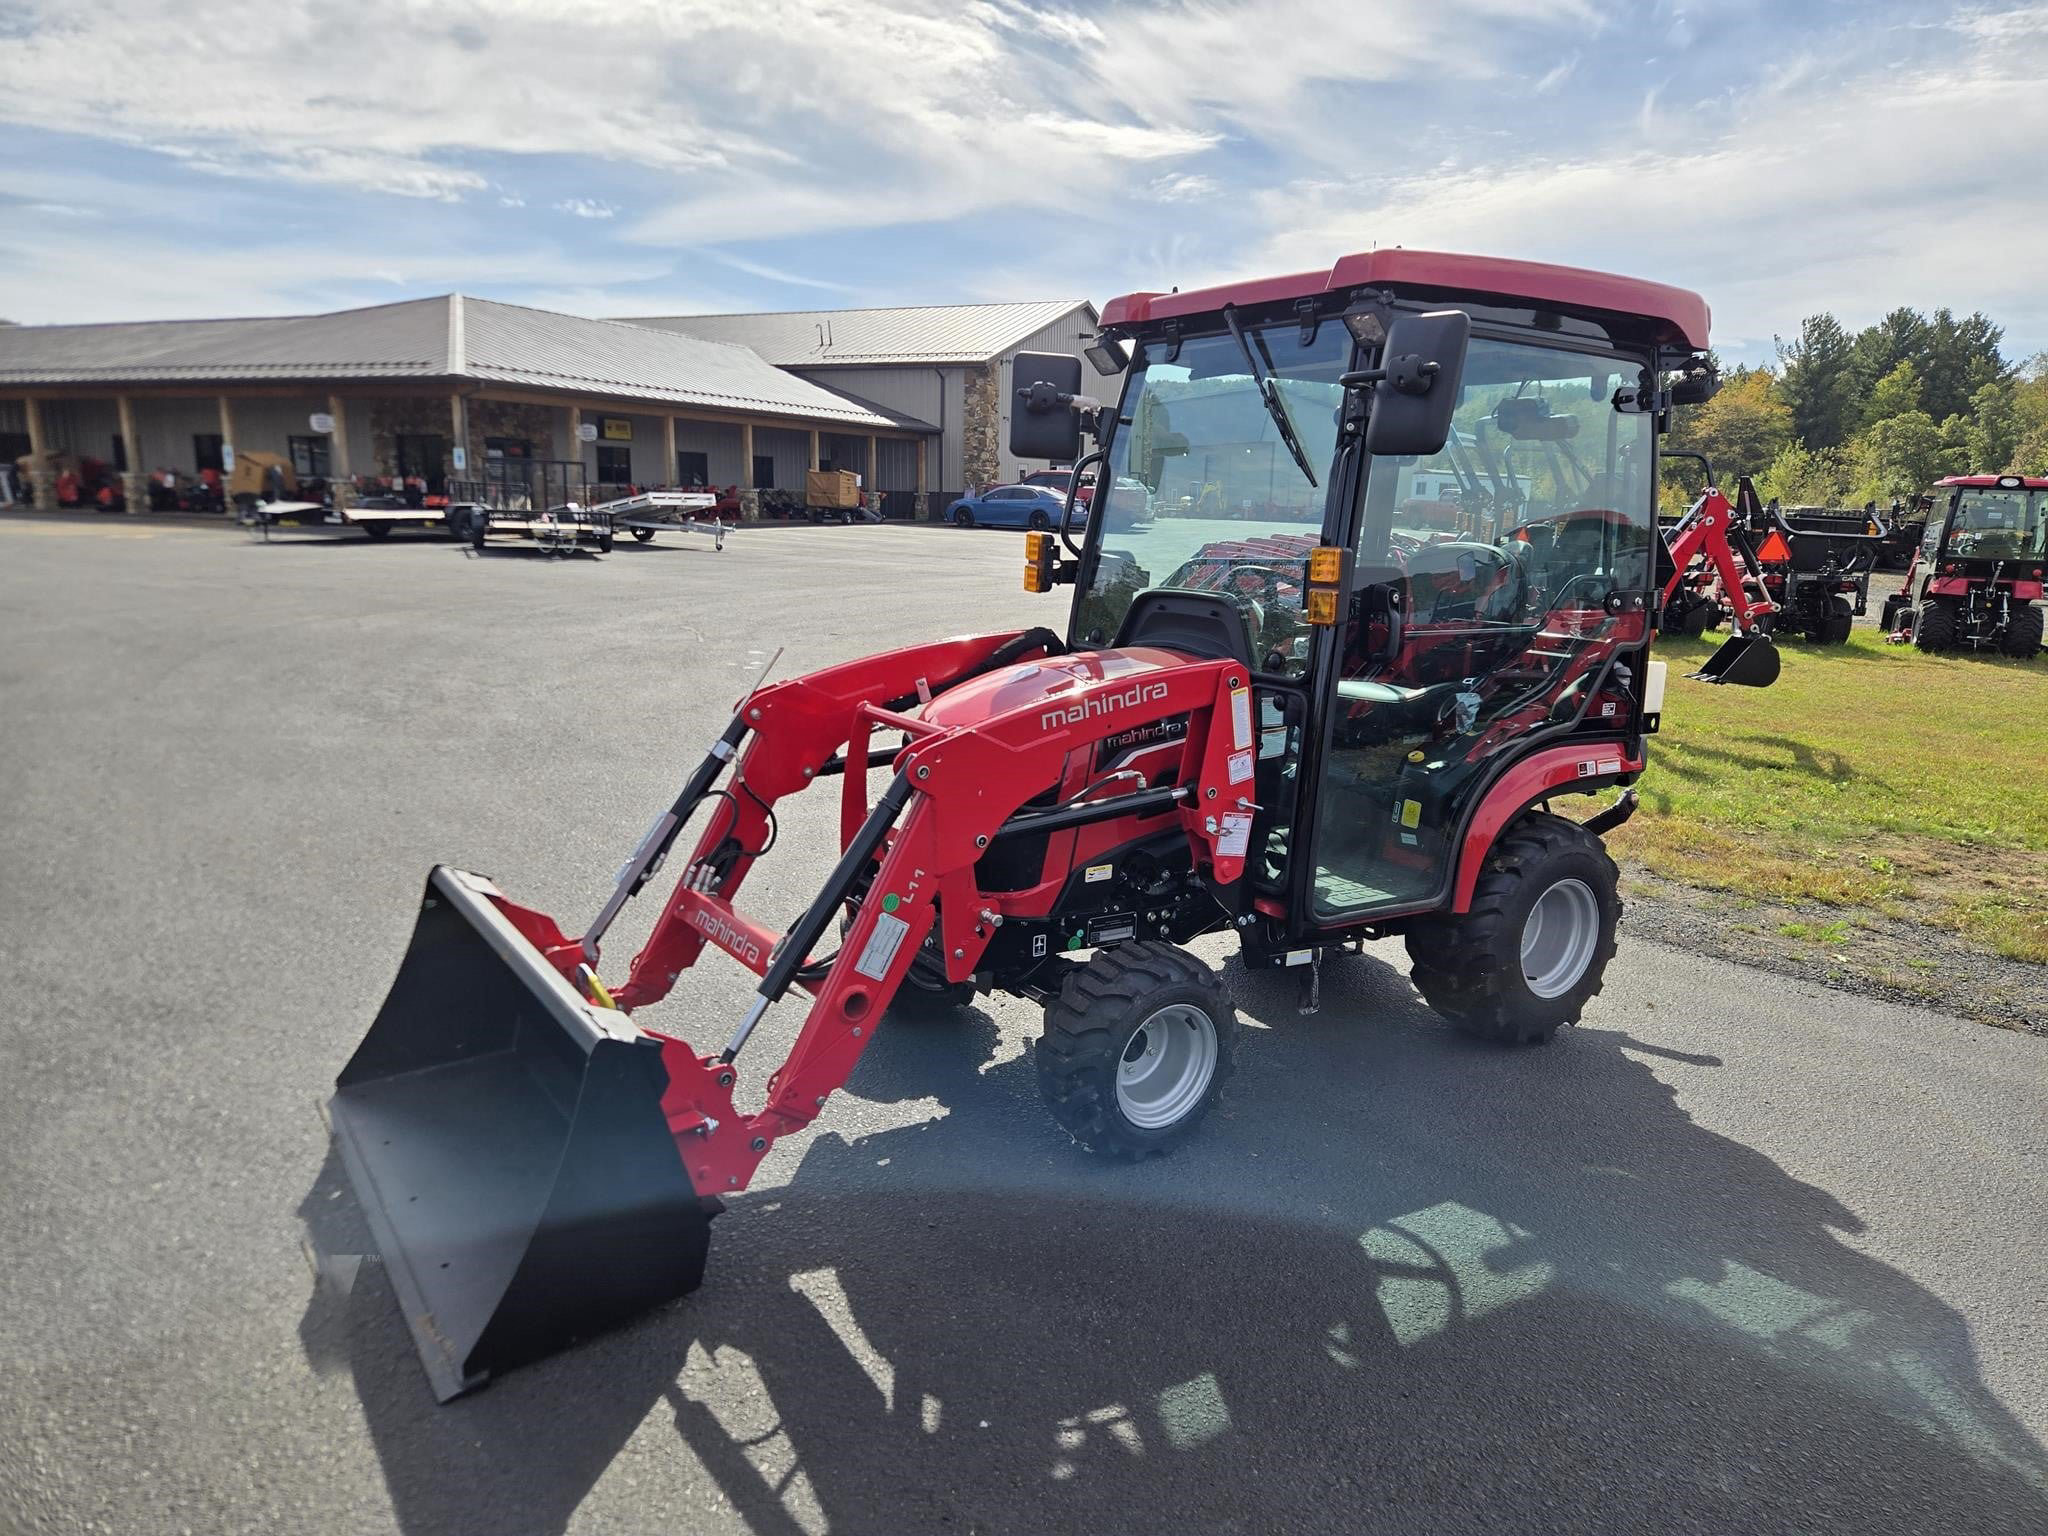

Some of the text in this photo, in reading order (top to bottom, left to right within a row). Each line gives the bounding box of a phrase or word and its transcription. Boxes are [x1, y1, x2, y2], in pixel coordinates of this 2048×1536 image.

[1041, 682, 1168, 730] mahindra
[1106, 722, 1181, 748] mahindra
[696, 910, 760, 964] mahindra
